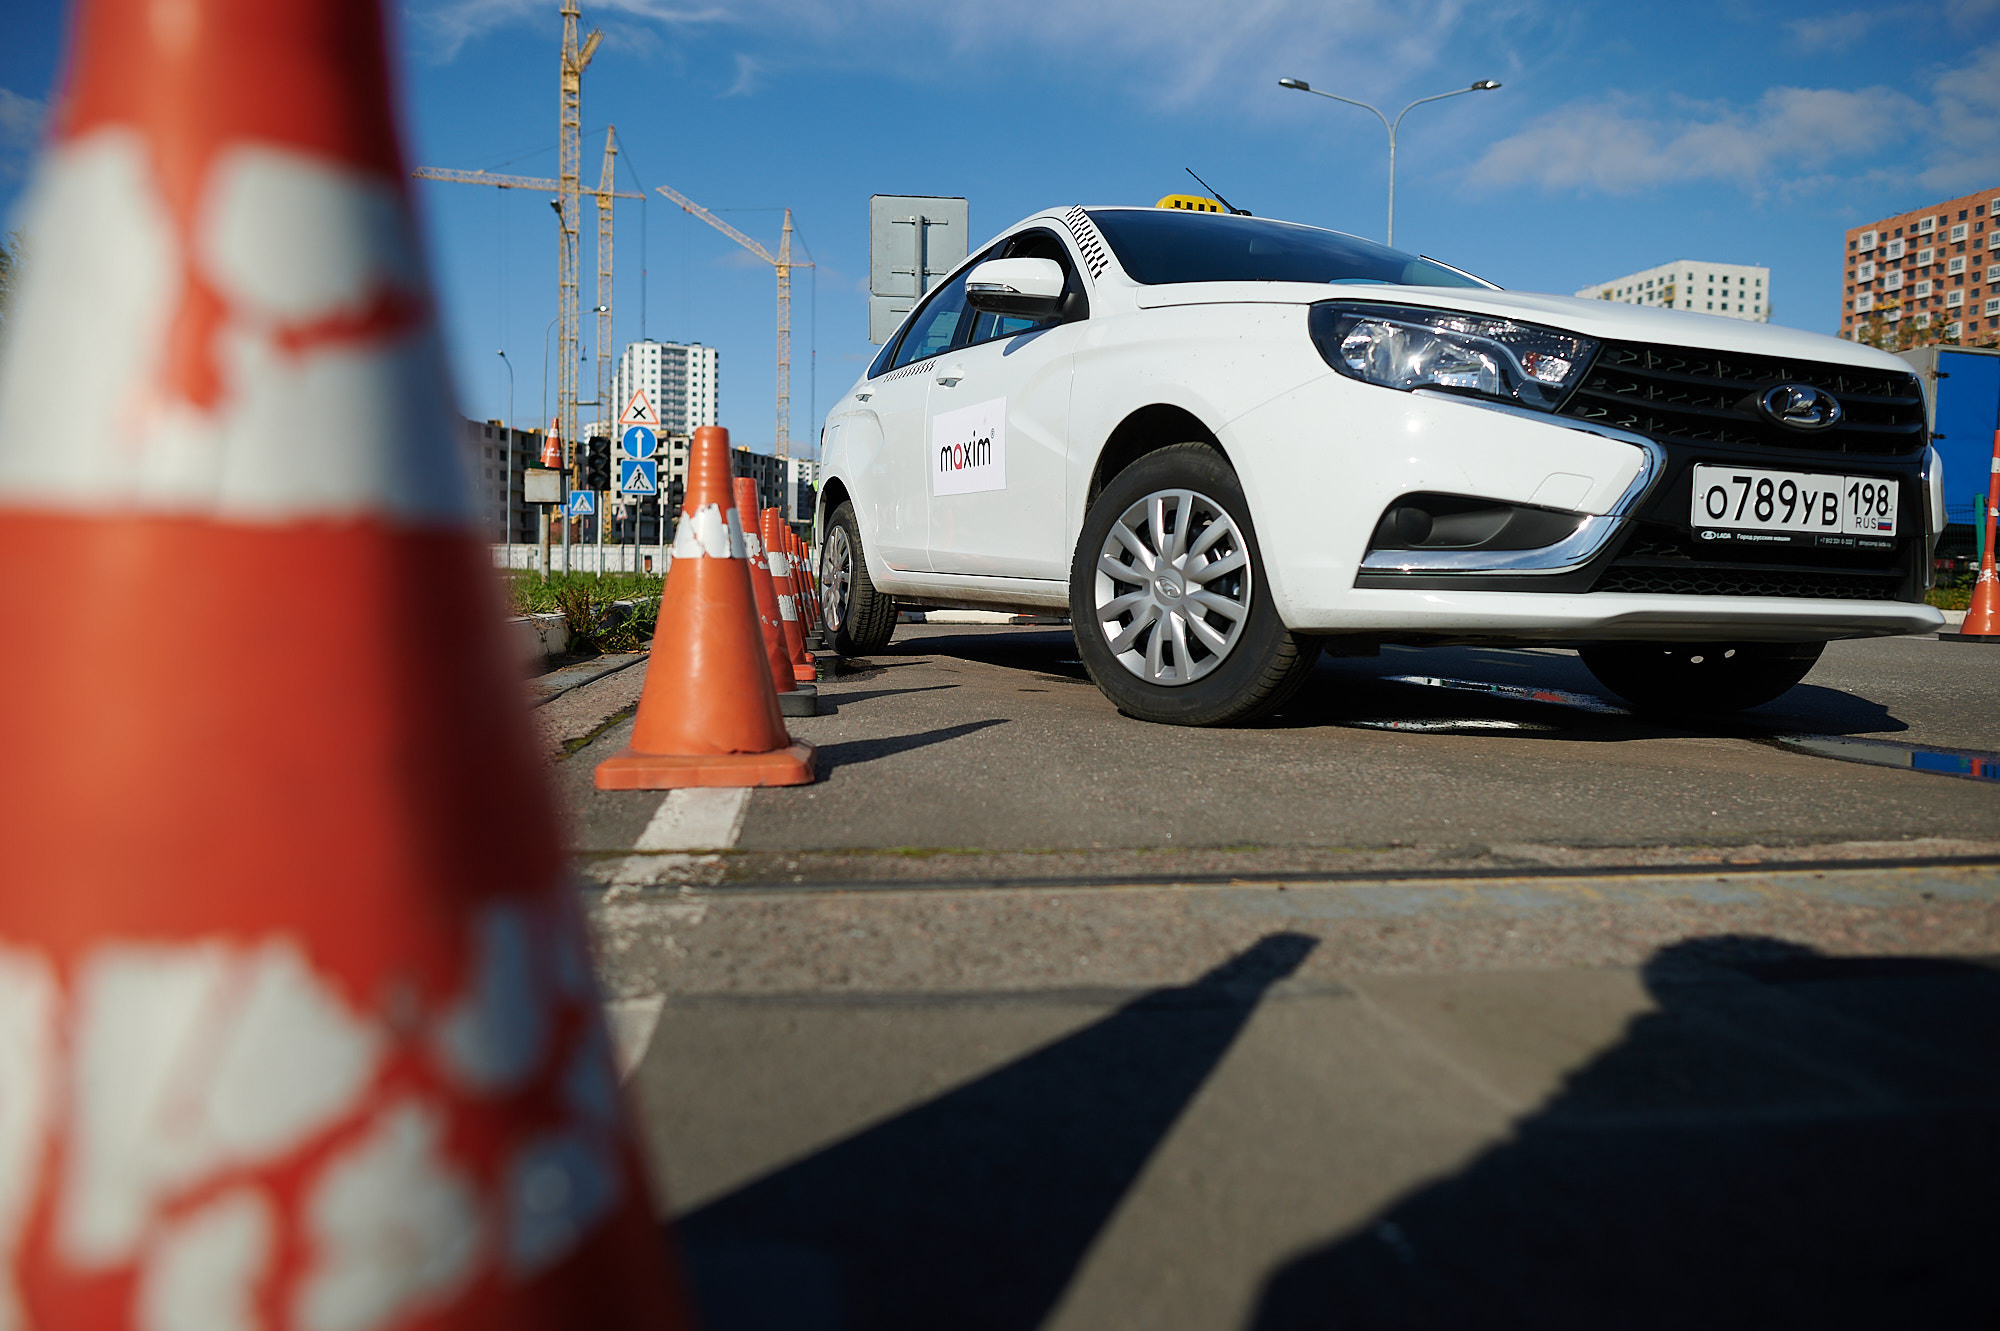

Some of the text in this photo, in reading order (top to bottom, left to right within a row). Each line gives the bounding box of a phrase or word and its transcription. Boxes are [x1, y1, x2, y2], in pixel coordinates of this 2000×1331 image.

[940, 429, 991, 472] maxim
[1705, 475, 1839, 526] О789УВ
[1847, 481, 1889, 517] 198
[1855, 516, 1877, 530] RUS
